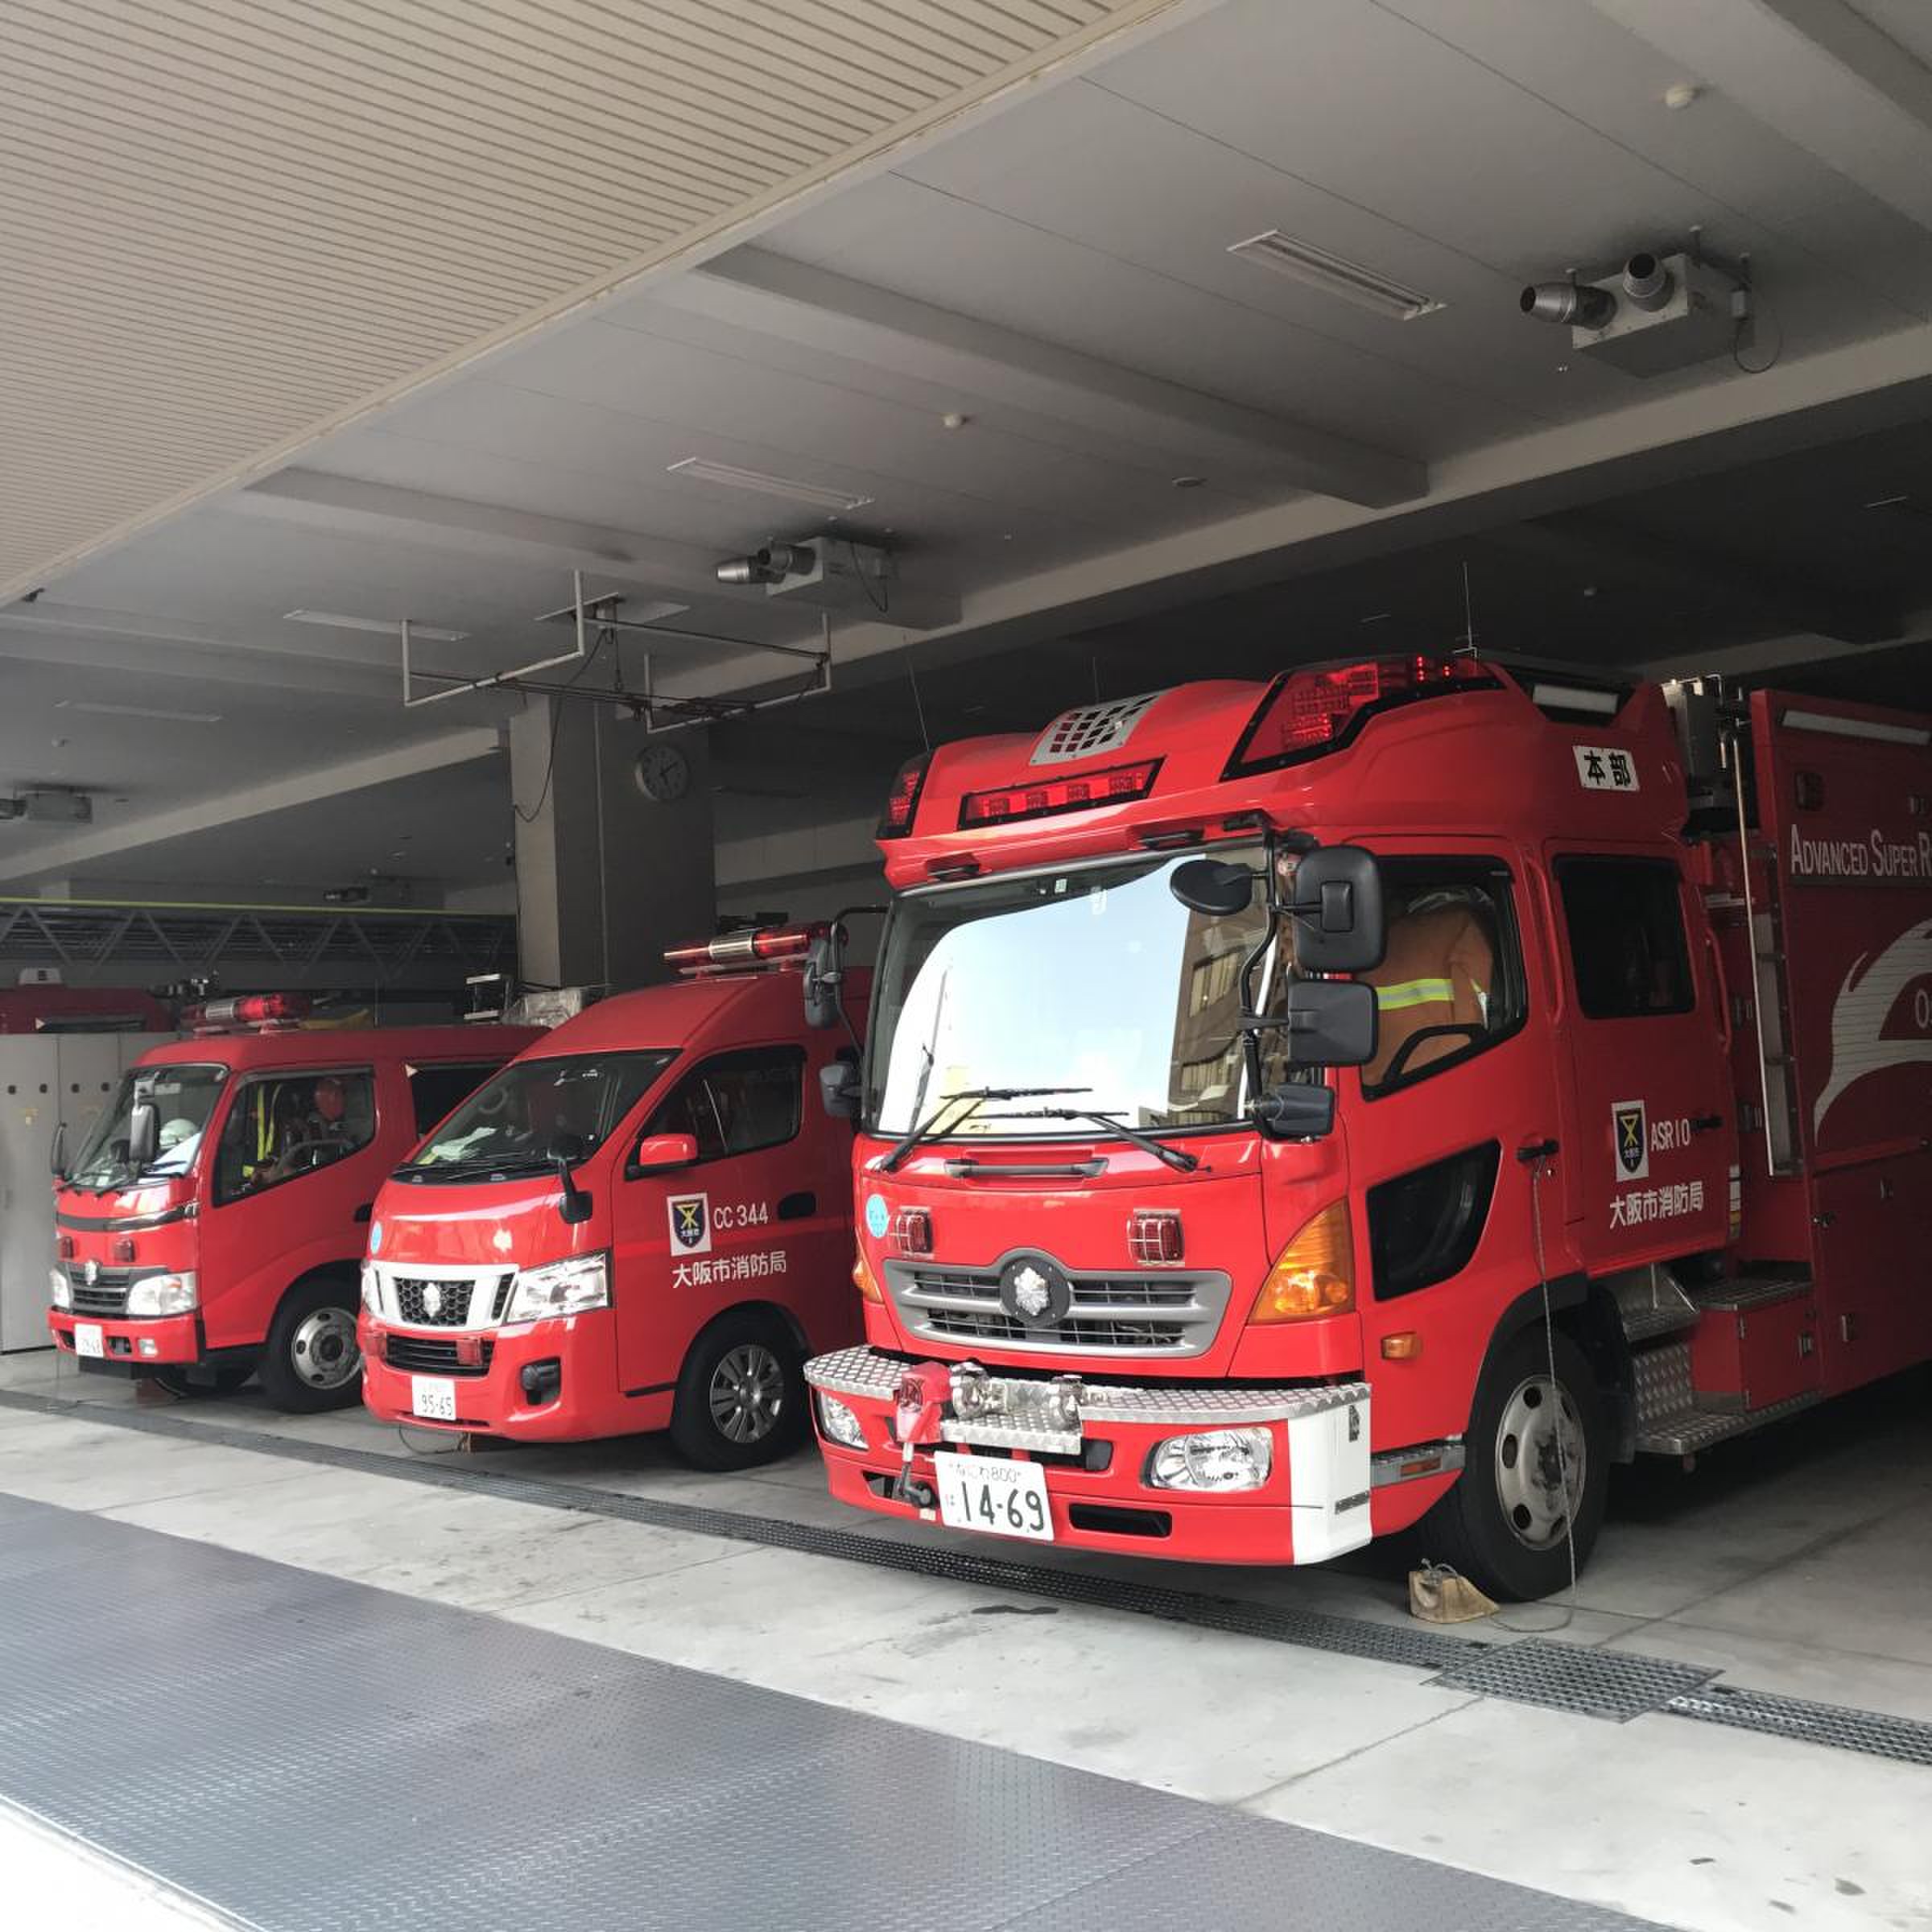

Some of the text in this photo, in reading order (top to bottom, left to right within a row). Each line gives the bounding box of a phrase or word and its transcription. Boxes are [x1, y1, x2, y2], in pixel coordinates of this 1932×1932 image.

[1583, 750, 1631, 786] 本部
[1791, 824, 1868, 876] ADVANCED
[1871, 829, 1918, 876] SUPER
[1610, 1181, 1703, 1229] 大阪市消防局
[672, 1250, 786, 1289] 大阪市消防局
[962, 1480, 1045, 1531] 14-69
